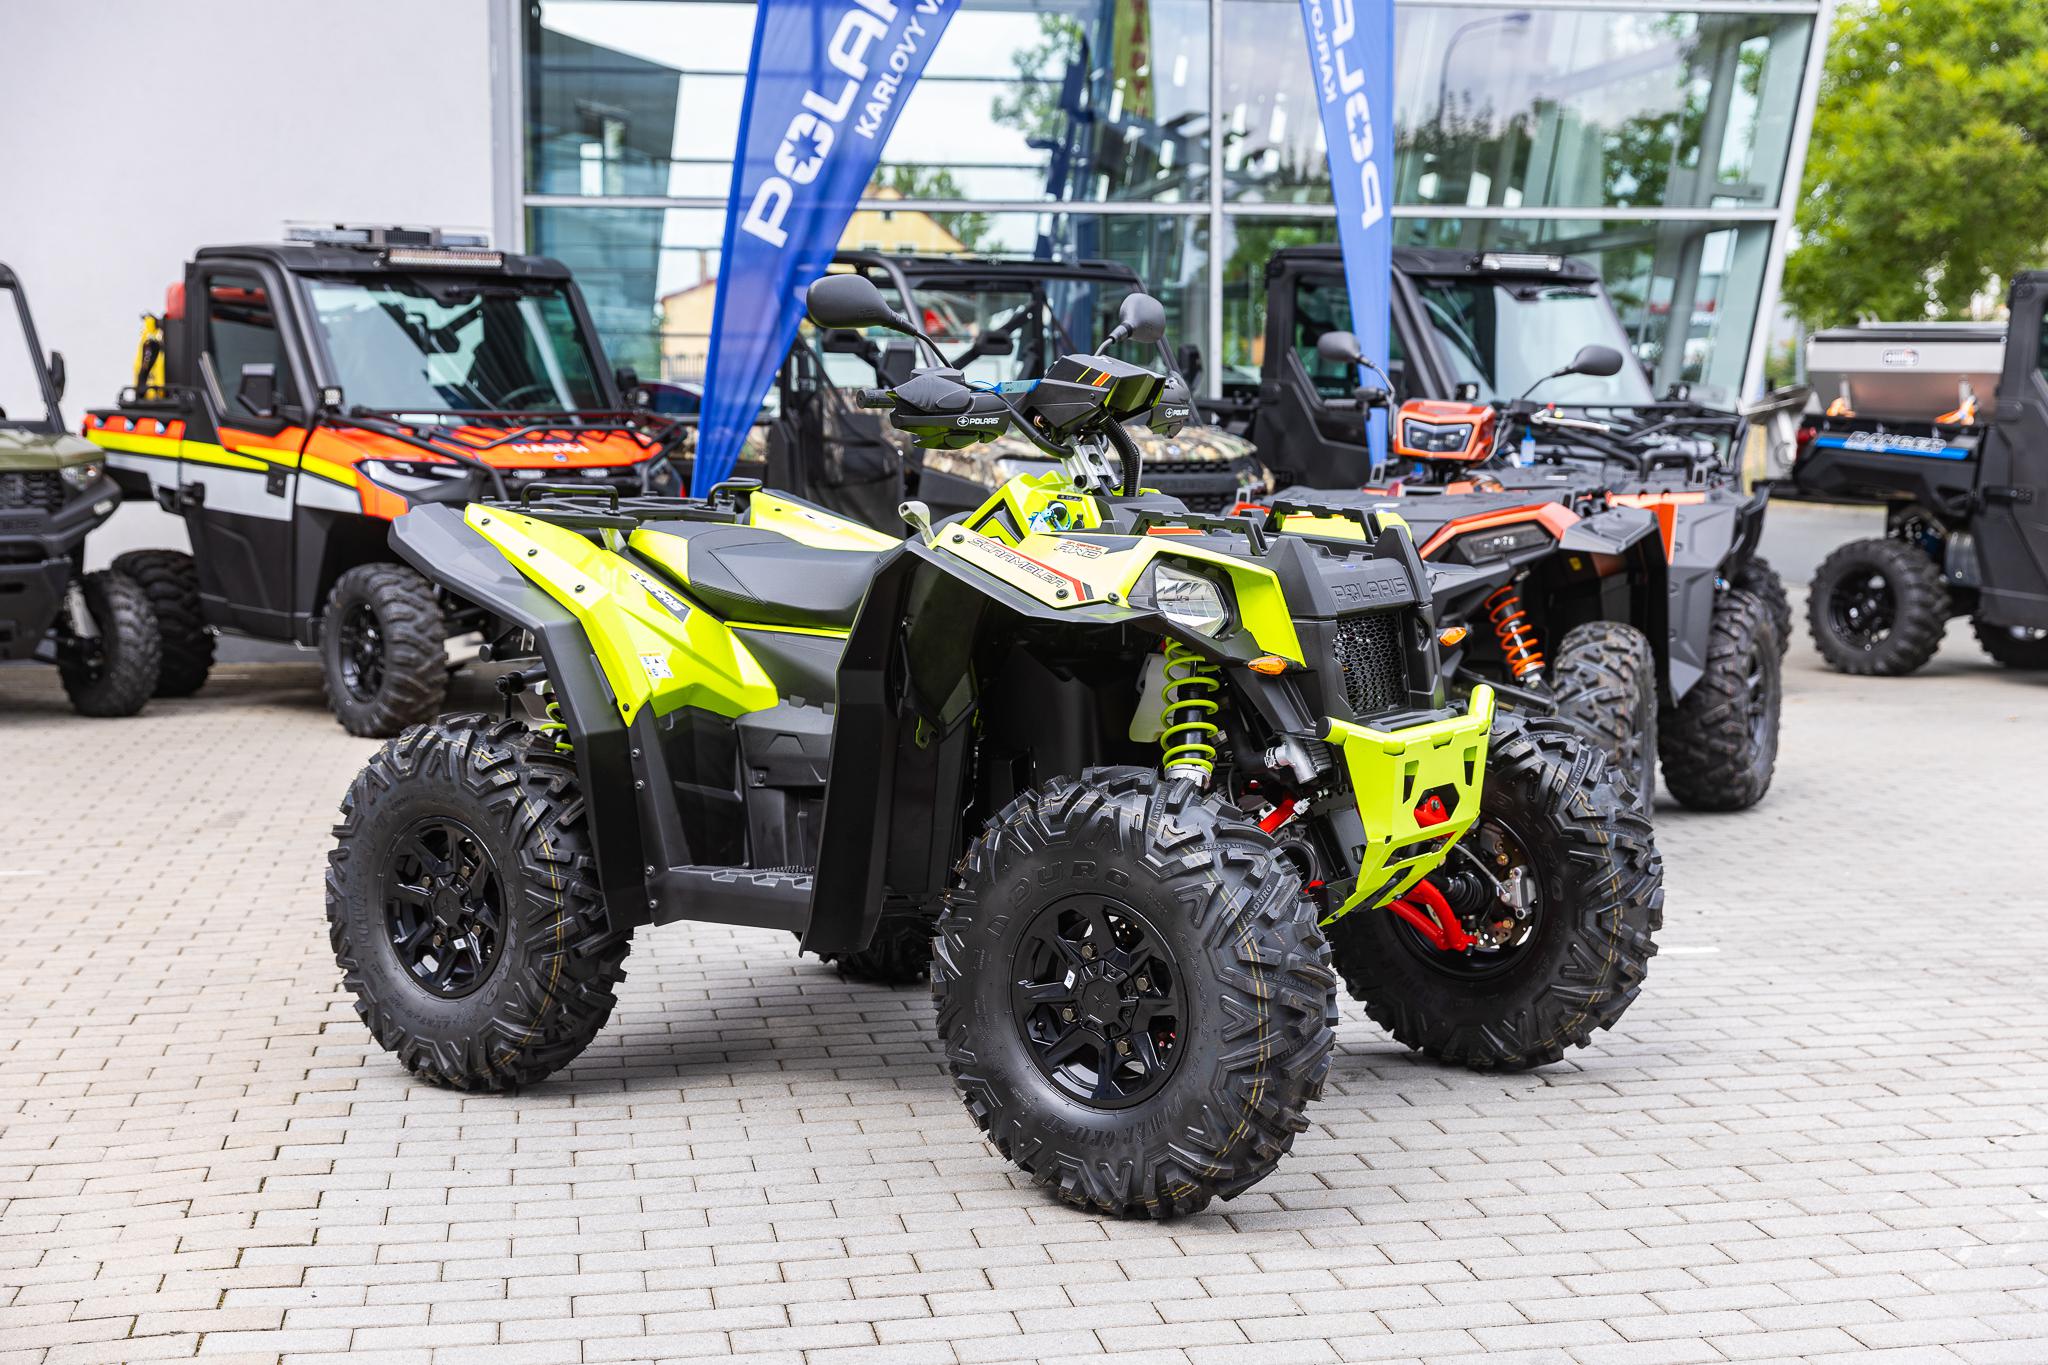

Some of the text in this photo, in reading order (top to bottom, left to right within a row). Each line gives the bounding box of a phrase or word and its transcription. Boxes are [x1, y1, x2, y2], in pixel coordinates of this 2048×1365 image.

[854, 14, 926, 139] KARLOVY
[969, 417, 1000, 425] POLARIS
[967, 537, 1068, 588] SCRAMBLER
[630, 571, 686, 612] POLARIS
[1330, 577, 1409, 604] POLARIS
[1010, 860, 1130, 908] DURO
